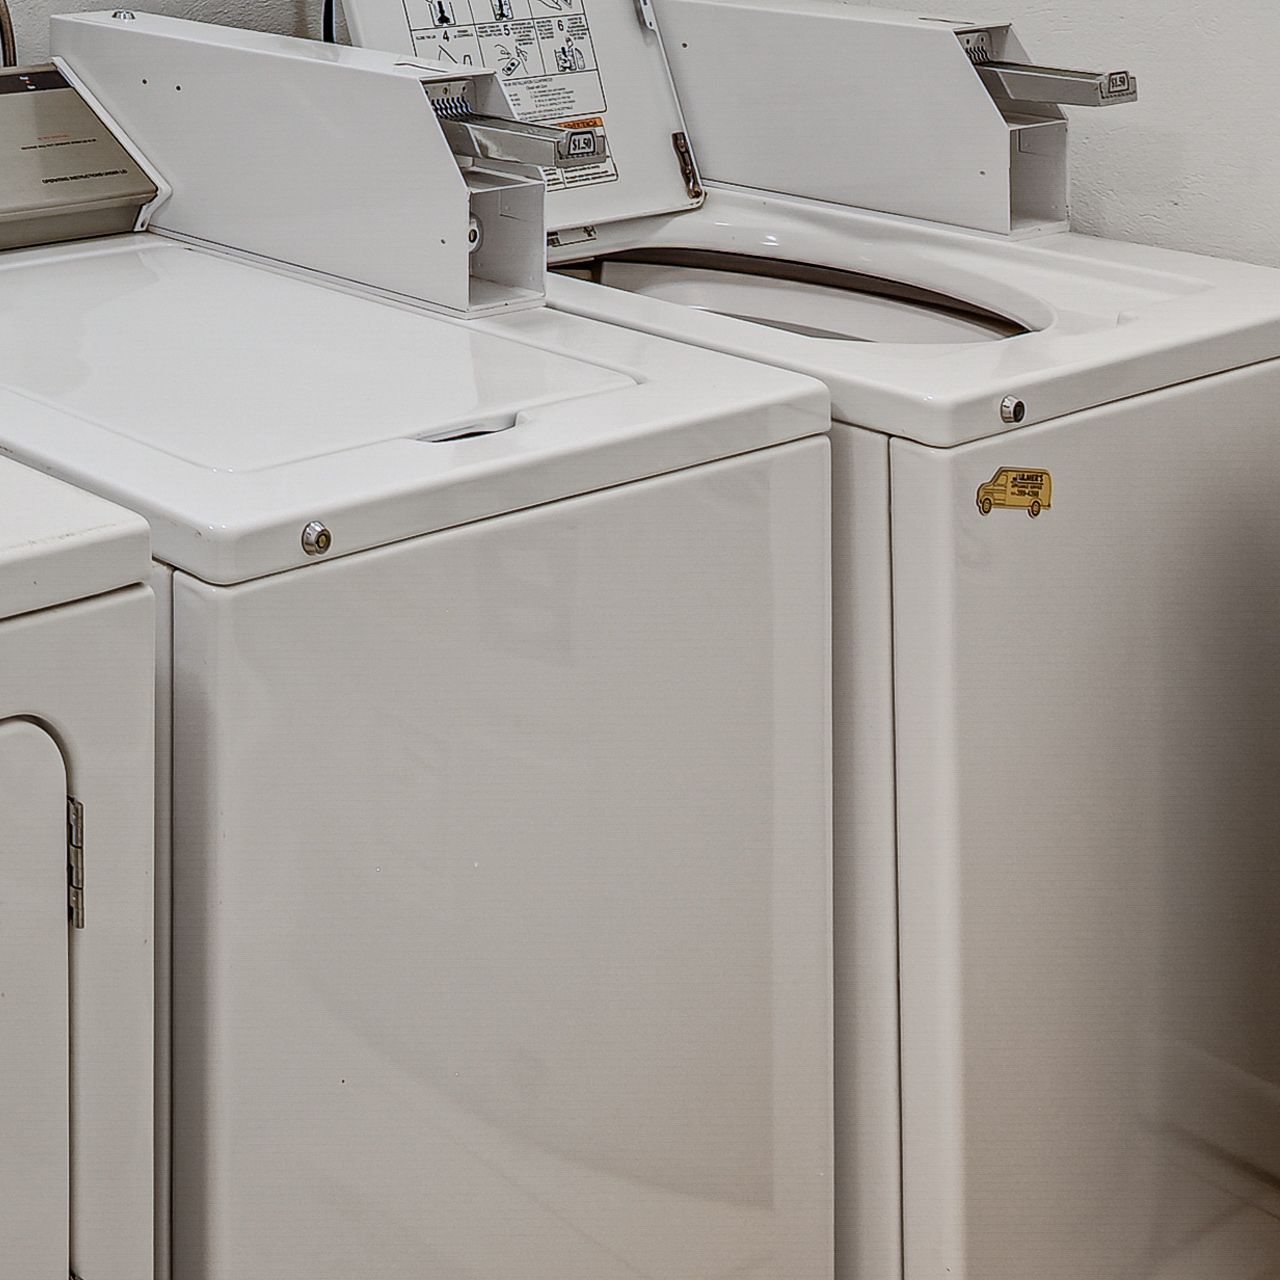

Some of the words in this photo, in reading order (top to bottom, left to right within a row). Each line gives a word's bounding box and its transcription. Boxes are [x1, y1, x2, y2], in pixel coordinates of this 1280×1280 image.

[504, 25, 510, 36] 5
[558, 20, 564, 31] 6
[442, 31, 449, 42] 4
[572, 137, 592, 151] $1.50
